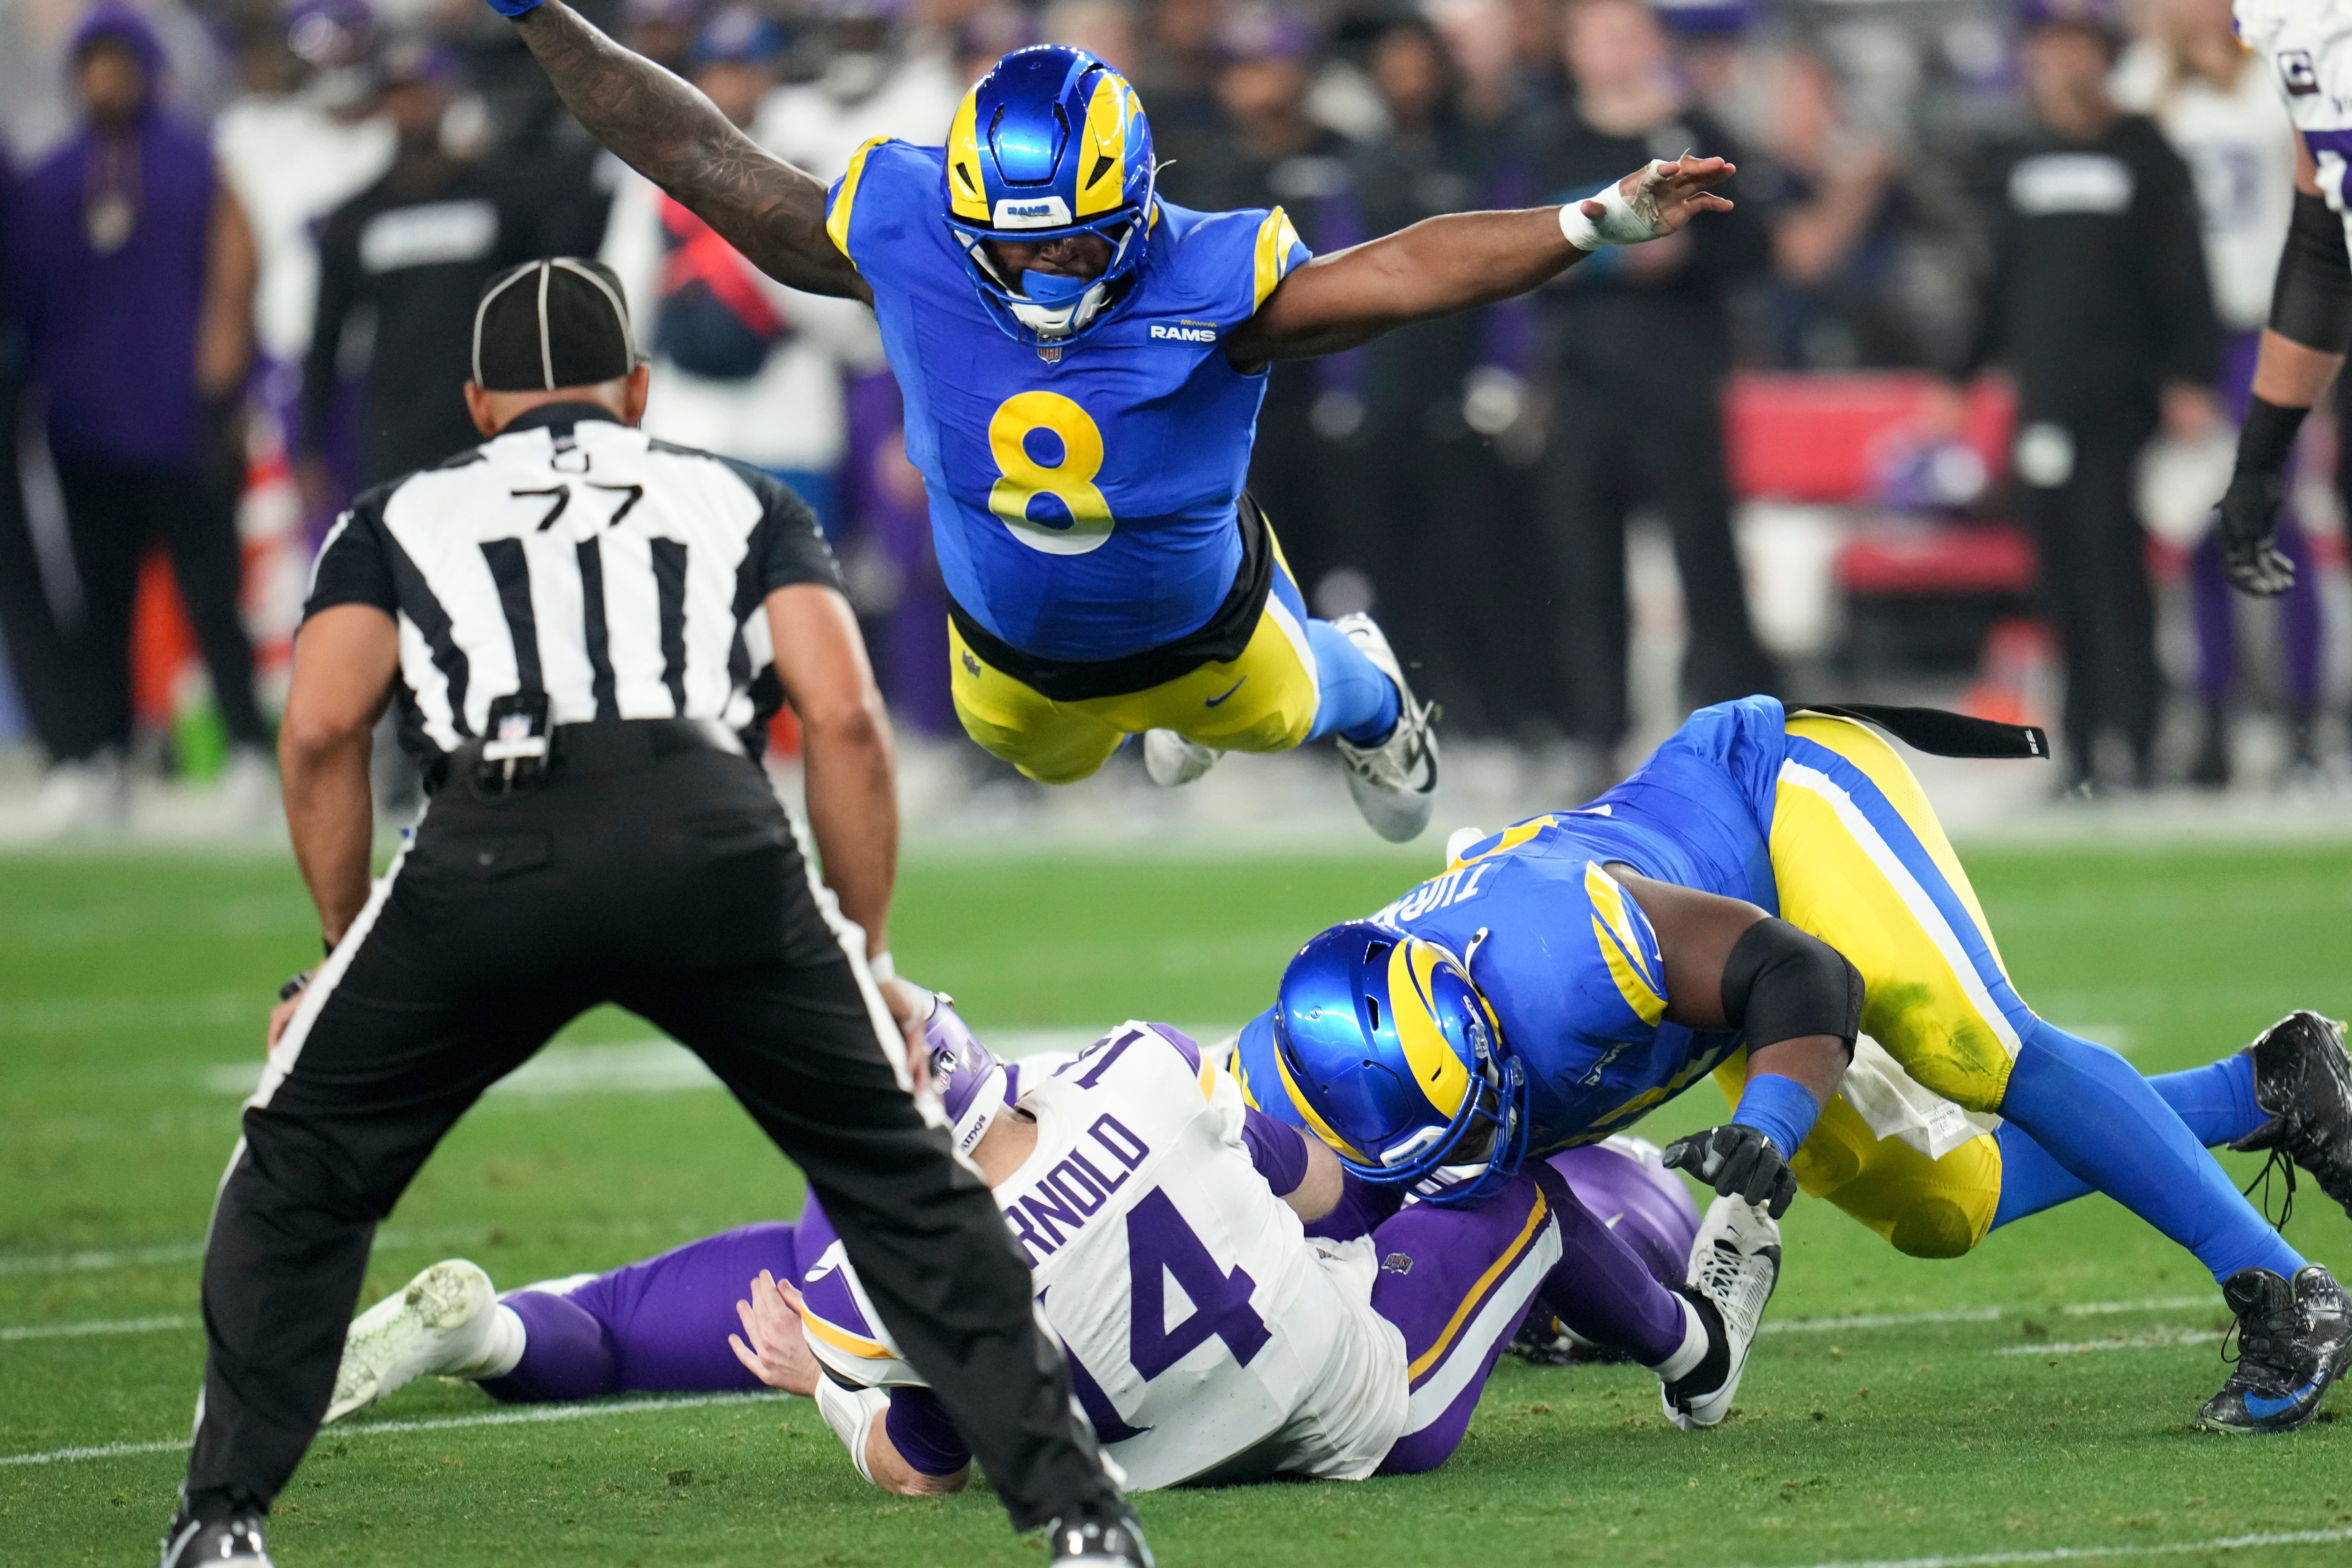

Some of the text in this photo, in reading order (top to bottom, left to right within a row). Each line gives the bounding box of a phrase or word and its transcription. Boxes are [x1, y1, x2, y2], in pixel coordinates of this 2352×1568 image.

[1007, 205, 1050, 215] RAMS
[1151, 326, 1216, 342] RAMS
[988, 390, 1115, 555] 8
[511, 483, 643, 532] 77
